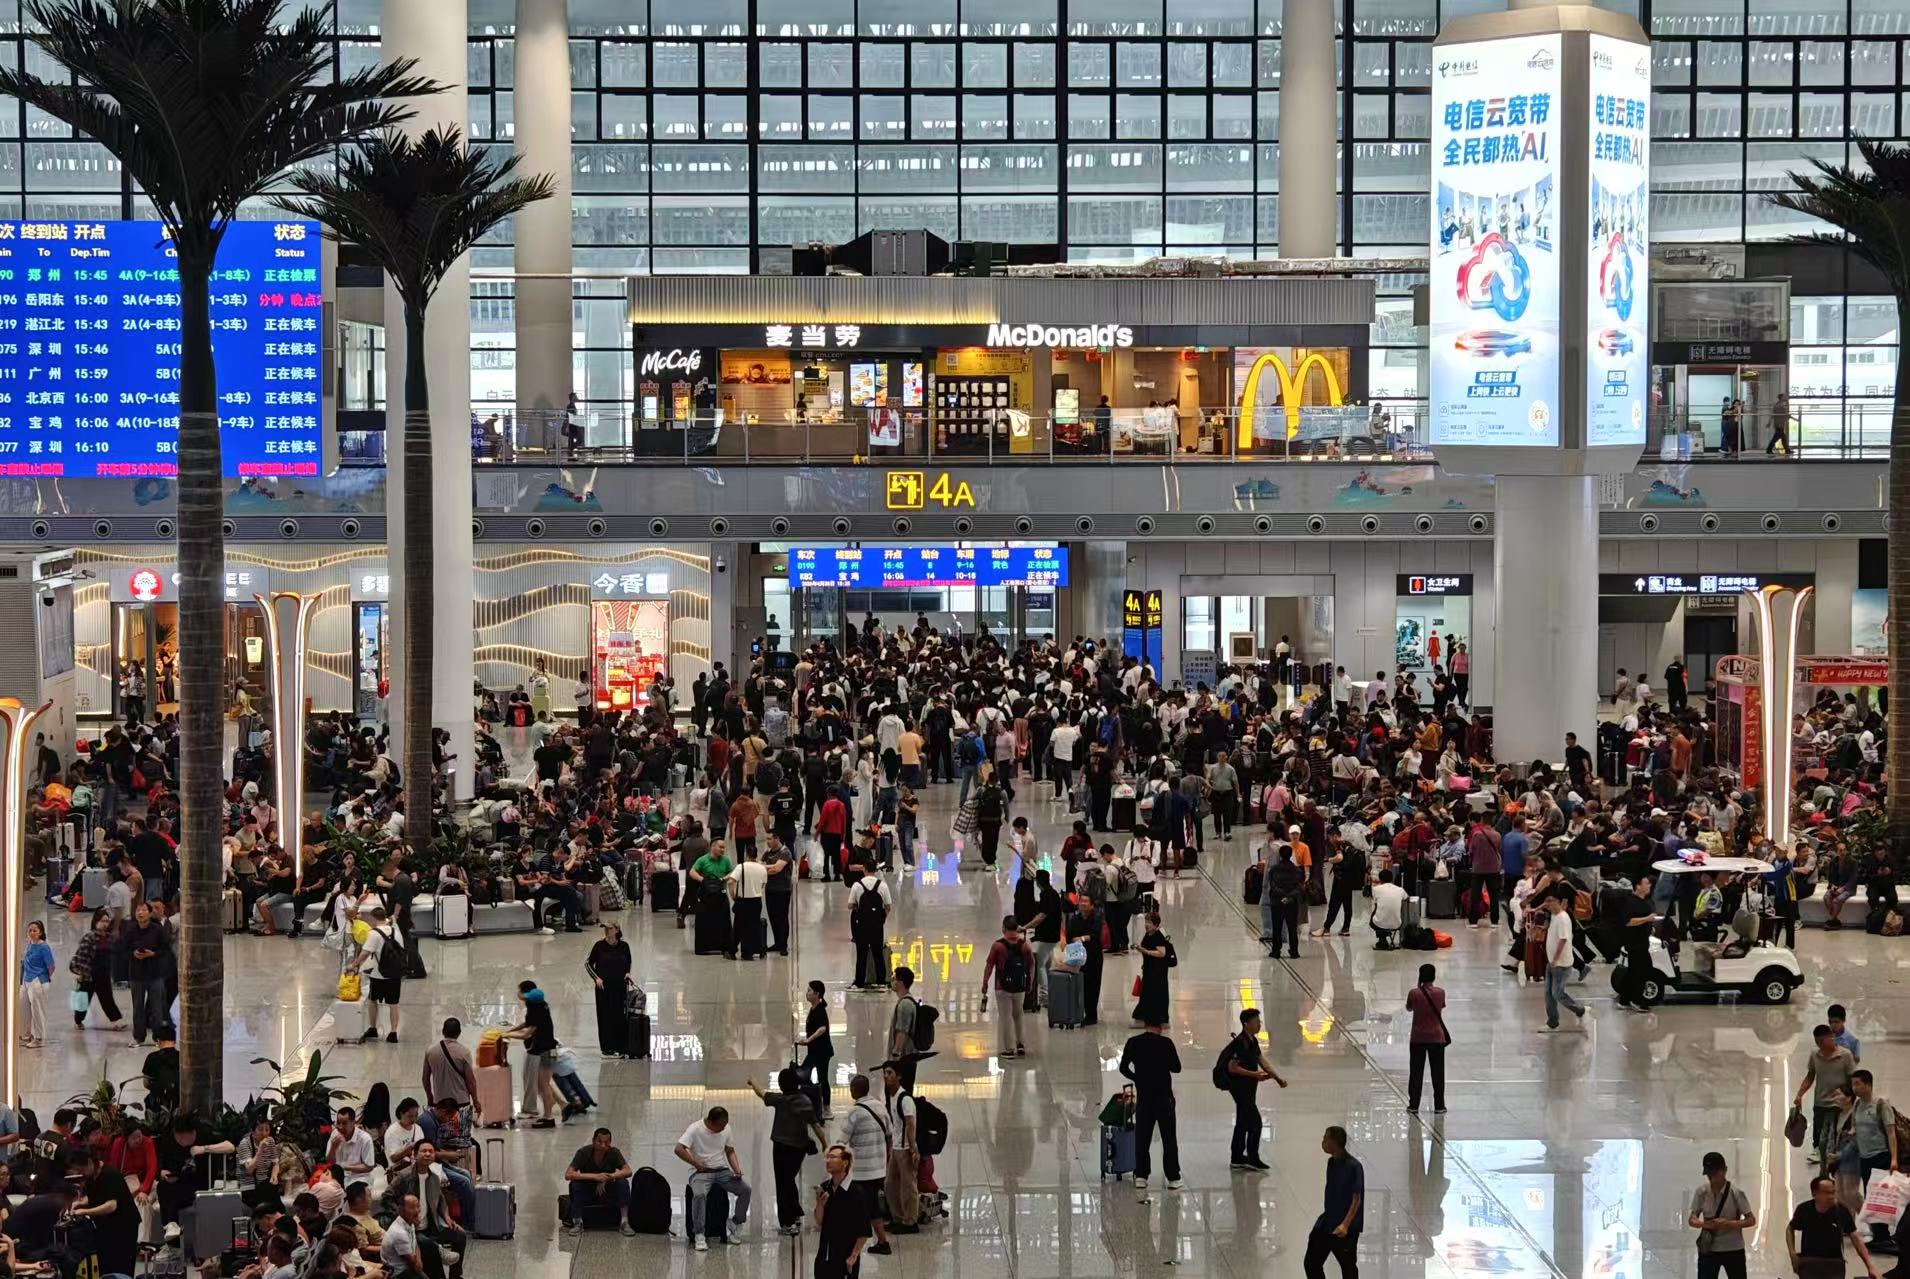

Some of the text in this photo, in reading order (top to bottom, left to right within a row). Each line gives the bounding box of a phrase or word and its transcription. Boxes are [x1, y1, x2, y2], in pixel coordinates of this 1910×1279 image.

[1444, 93, 1551, 131] 电信云宽带
[1595, 93, 1645, 130] 电信云宽带
[20, 224, 68, 240] 终到站
[74, 224, 106, 240] 开点
[274, 224, 306, 241] 状态
[37, 248, 51, 257] To
[70, 248, 110, 259] Dep.Tim
[275, 249, 305, 257] Status
[74, 270, 108, 280] 15:45
[264, 269, 317, 282] 正在检票
[25, 293, 64, 306] 岳阳东
[74, 294, 108, 305] 15:40
[25, 318, 65, 331] 湛江北
[74, 319, 108, 330] 15:43
[264, 318, 316, 331] 正在候车
[766, 325, 861, 347] 麦当劳
[987, 324, 1134, 347] McDonald's
[28, 342, 62, 355] 深圳
[74, 343, 109, 354] 15:46
[264, 342, 317, 355] 正在候车
[641, 349, 702, 376] McCafé
[28, 367, 62, 380] 广州
[74, 368, 109, 379] 15:59
[264, 367, 317, 380] 正在候车
[26, 391, 65, 405] 北京西
[75, 392, 109, 404] 16:00
[264, 391, 317, 404] 正在候车
[28, 416, 62, 429] 宝鸡
[75, 417, 109, 428] 16:06
[265, 416, 317, 429] 正在候车
[29, 440, 62, 454] 深圳
[75, 441, 109, 453] 16:10
[265, 441, 317, 453] 正在候车
[929, 473, 975, 507] 4A
[883, 562, 904, 570] 15:45
[883, 573, 904, 581] 16:06
[926, 572, 936, 580] 14
[1427, 577, 1460, 587] 女卫生间
[593, 573, 668, 595] 今香
[1126, 593, 1141, 612] 4A
[1148, 593, 1161, 611] 4A
